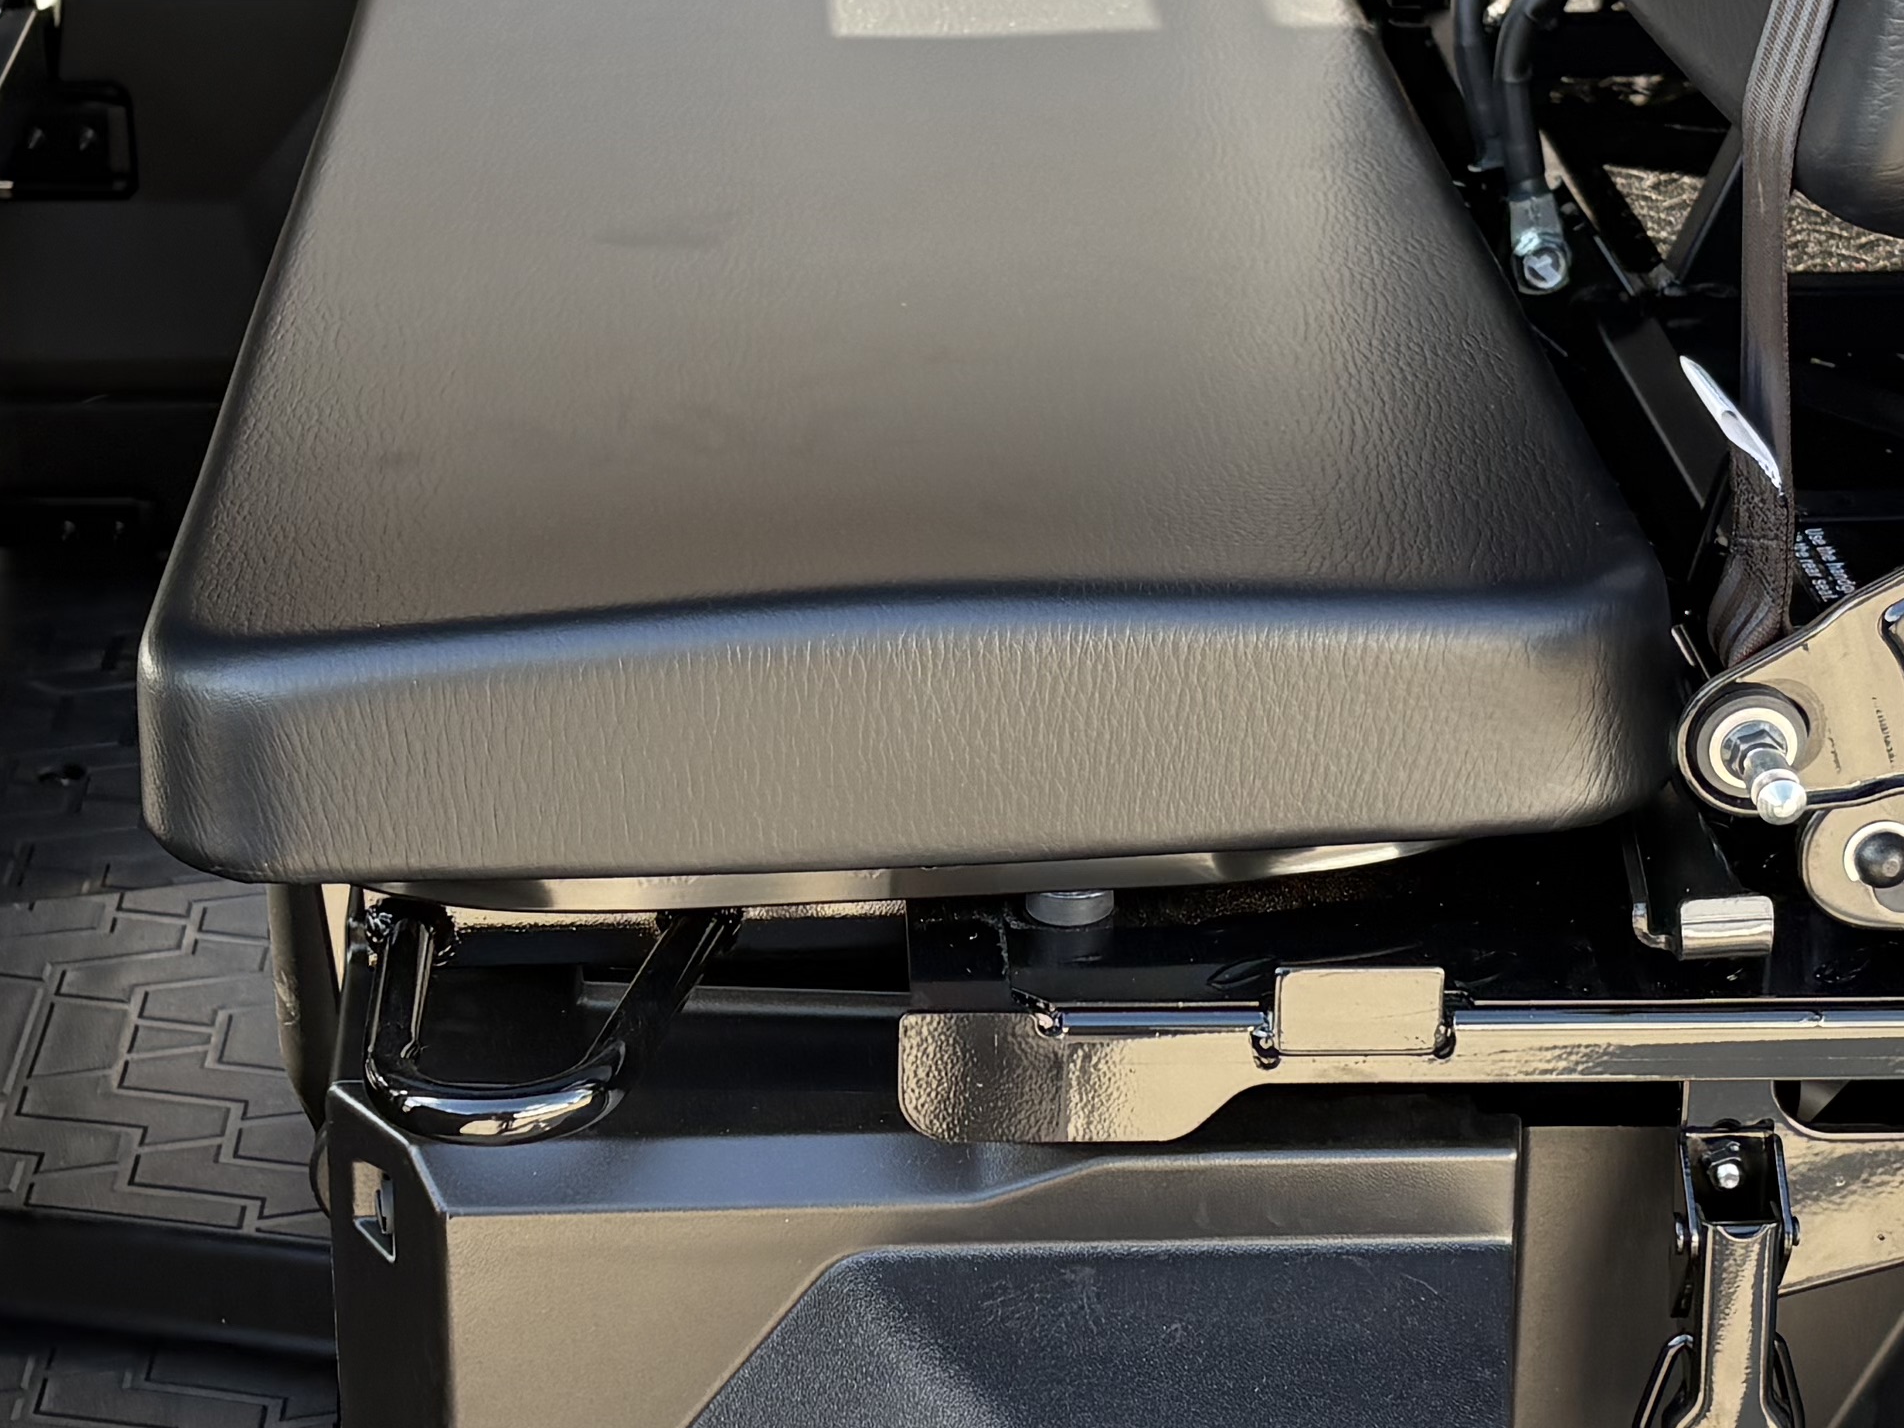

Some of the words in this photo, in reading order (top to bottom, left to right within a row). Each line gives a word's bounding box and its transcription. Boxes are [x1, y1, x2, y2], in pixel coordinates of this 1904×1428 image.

[1804, 528, 1827, 546] Use
[1816, 545, 1837, 562] the
[1799, 559, 1822, 578] rear
